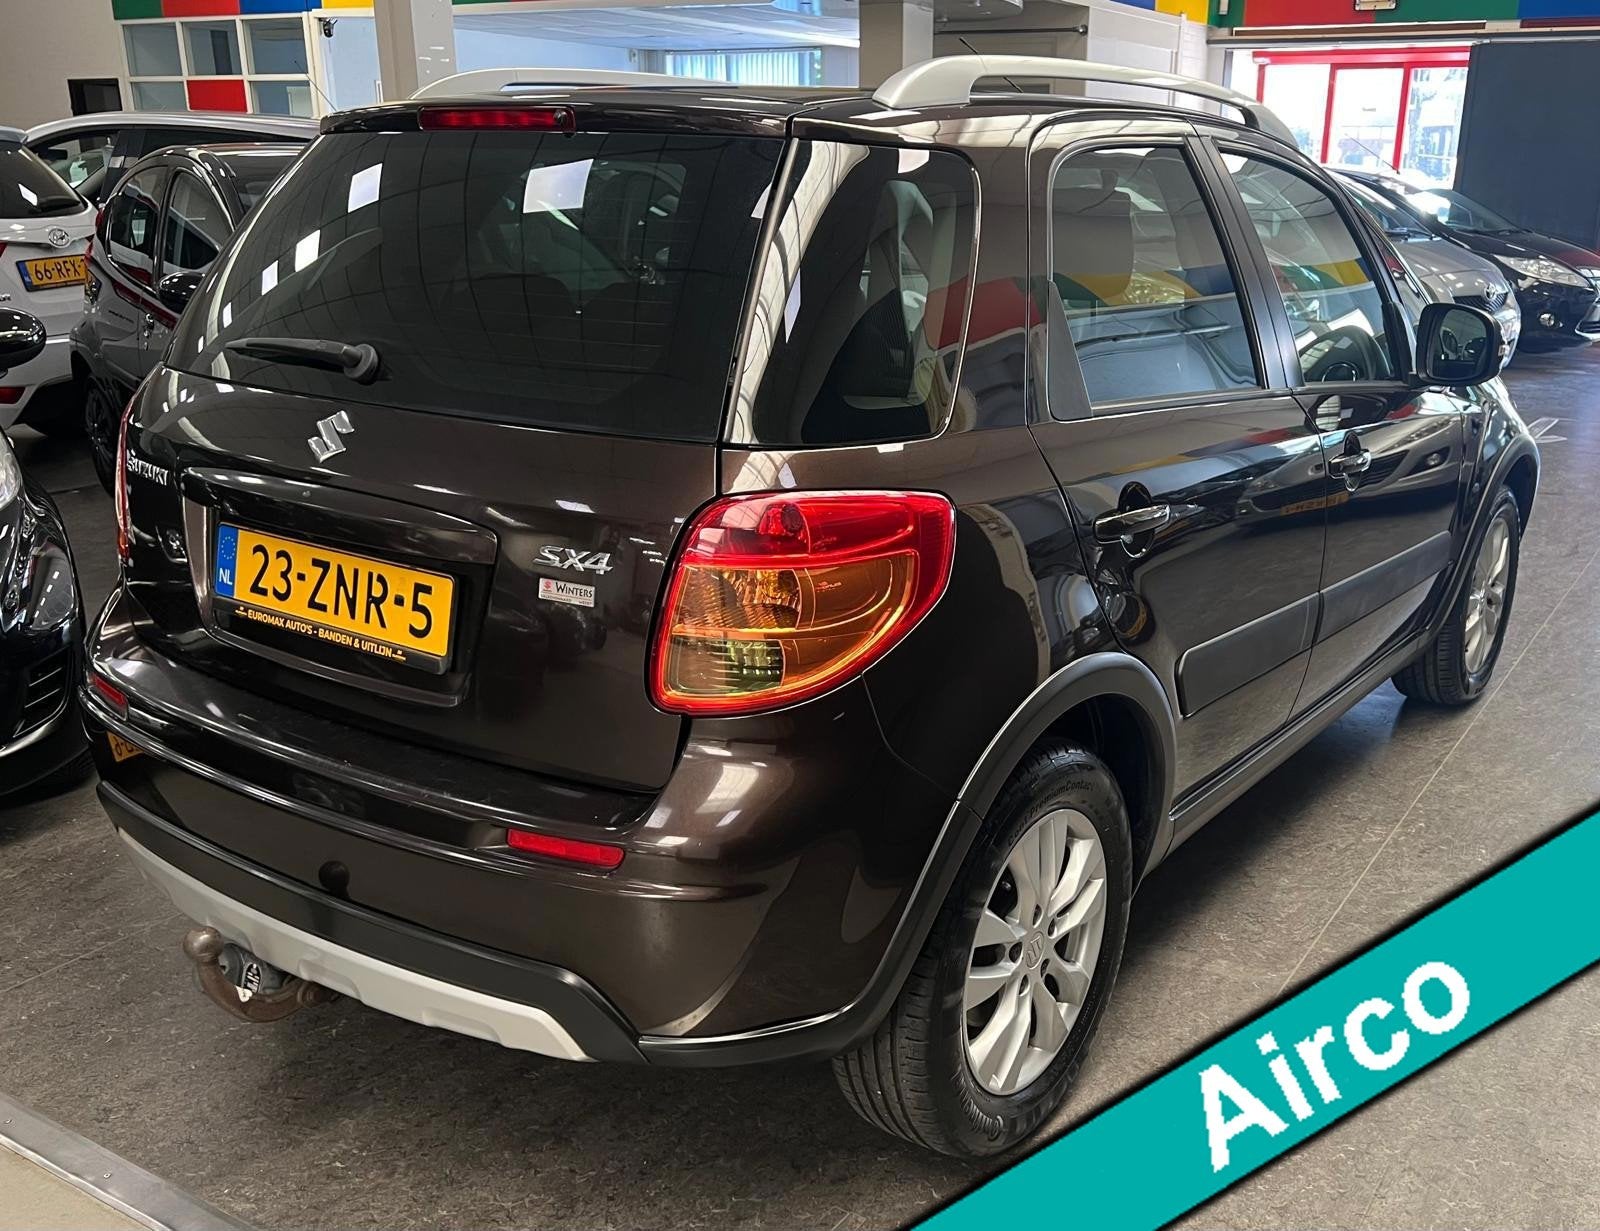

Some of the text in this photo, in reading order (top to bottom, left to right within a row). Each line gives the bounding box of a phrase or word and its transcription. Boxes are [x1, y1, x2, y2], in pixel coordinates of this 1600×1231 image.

[34, 259, 85, 281] 66-RFX-
[532, 545, 613, 575] SX4
[219, 568, 232, 585] NL
[249, 544, 433, 639] 23-ZNR-5
[247, 609, 285, 628] EUROMAX
[285, 619, 313, 635] AUTO'S
[318, 628, 353, 647] BANDEN
[353, 638, 360, 649] &
